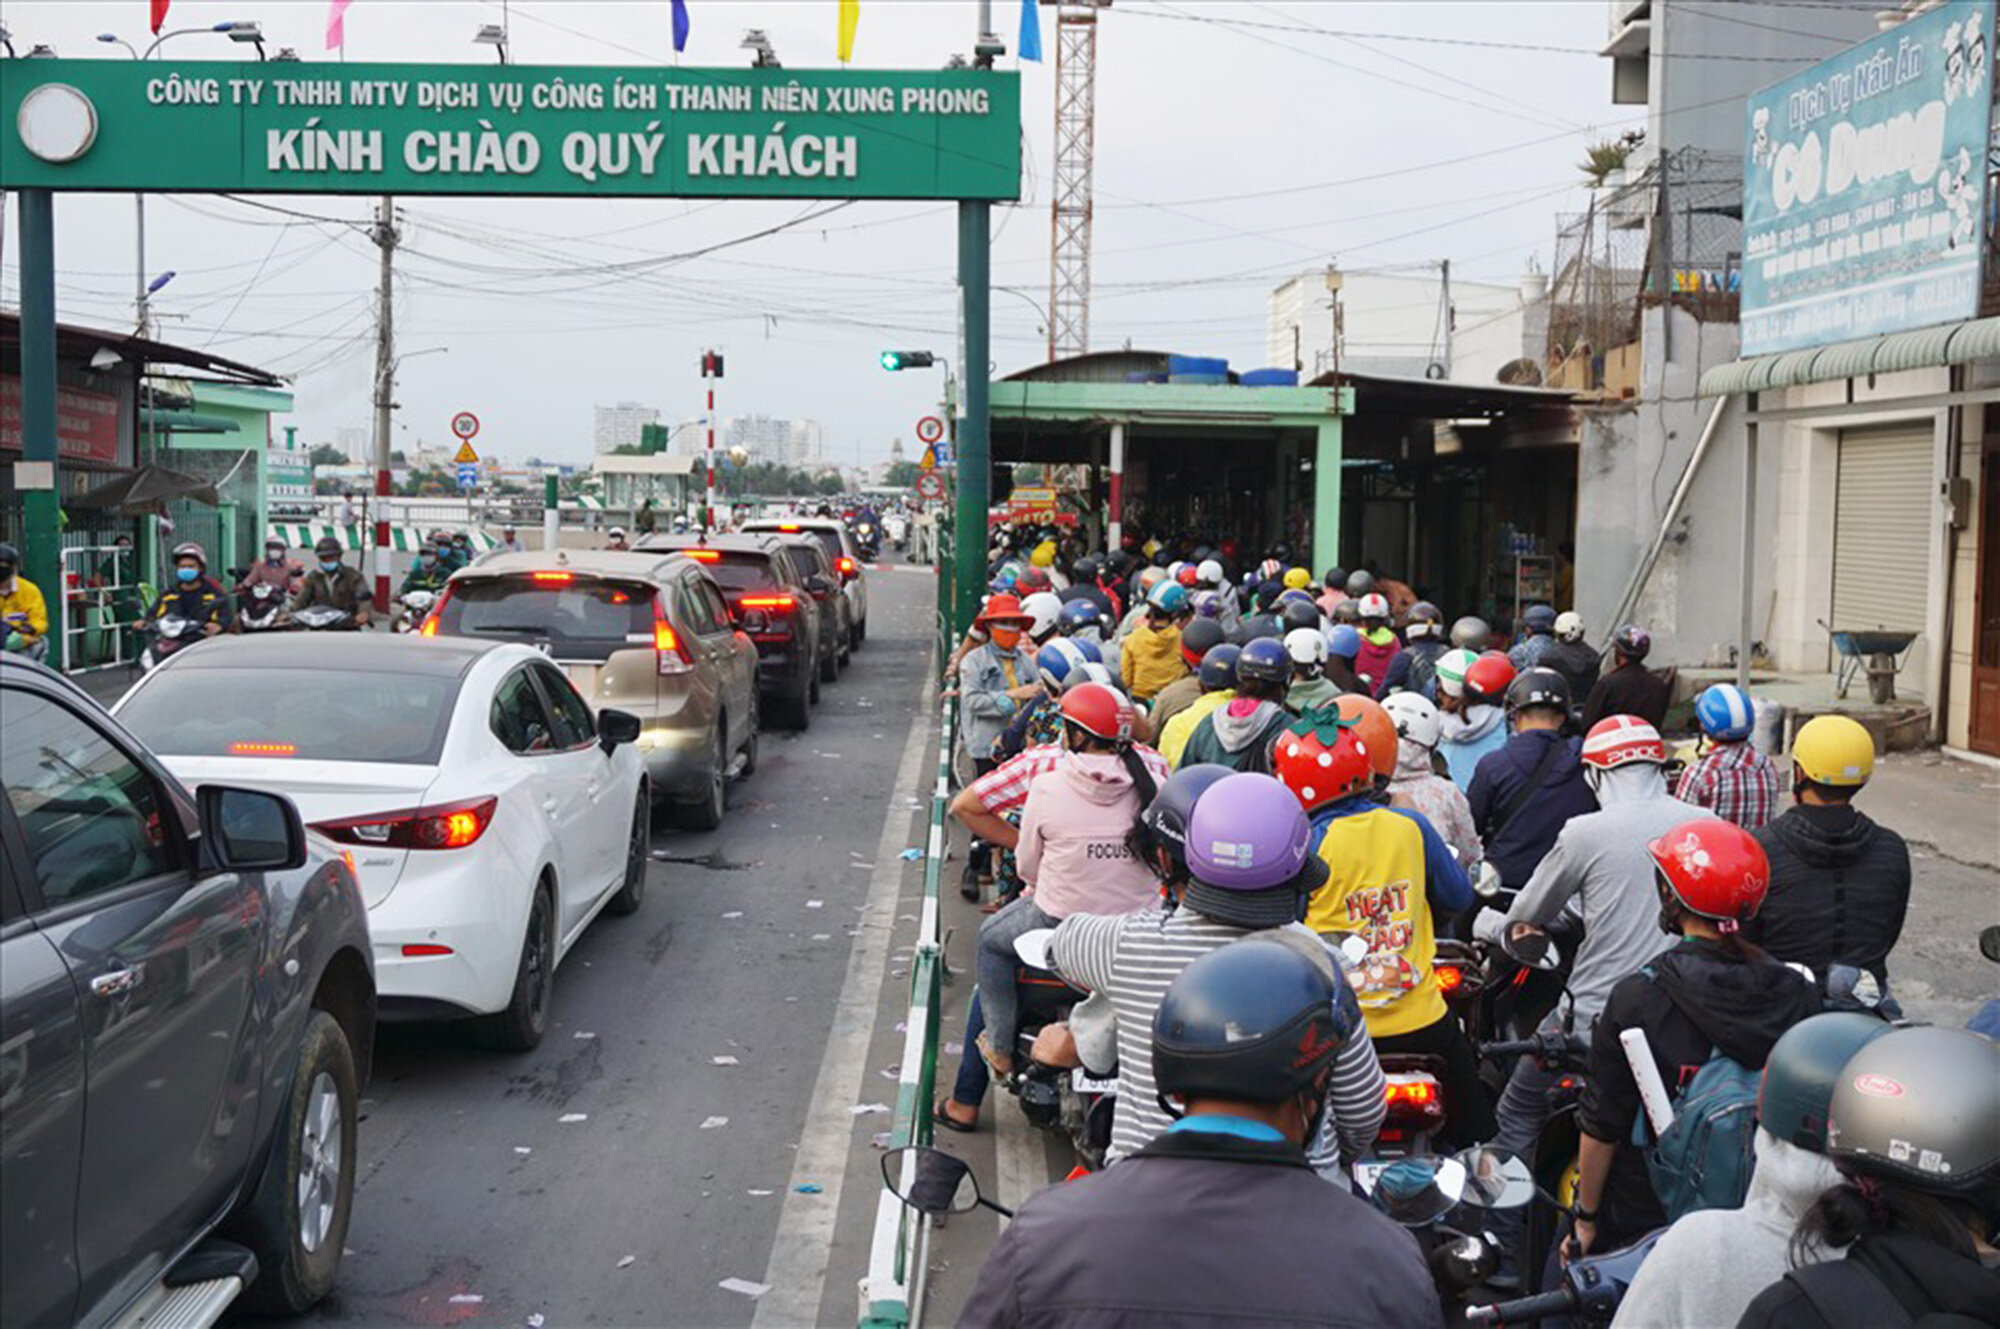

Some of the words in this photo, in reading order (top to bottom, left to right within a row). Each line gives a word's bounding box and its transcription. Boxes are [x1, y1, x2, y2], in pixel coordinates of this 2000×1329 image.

[146, 73, 219, 104] CÔNG
[228, 79, 263, 104] TY
[273, 80, 342, 105] TNHH
[350, 81, 408, 106] MTV
[417, 82, 478, 113] DỊCH
[488, 83, 523, 113] VỤ
[532, 77, 604, 109] CÔNG
[613, 77, 657, 109] ÍCH
[665, 83, 752, 111] THANH
[761, 80, 819, 112] NIÊN
[826, 87, 895, 113] XUNG
[901, 88, 990, 115] PHONG
[1788, 81, 1828, 131] Dịch
[1829, 72, 1852, 114] Vụ
[1853, 48, 1895, 102] Nấu
[1895, 36, 1924, 86] Ăn
[267, 117, 383, 171] KÍNH
[403, 119, 540, 174] CHÀO
[561, 120, 665, 181] QUÝ
[687, 121, 857, 177] KHÁCH
[1086, 842, 1130, 860] FOCUS
[1345, 882, 1408, 922] HEAT
